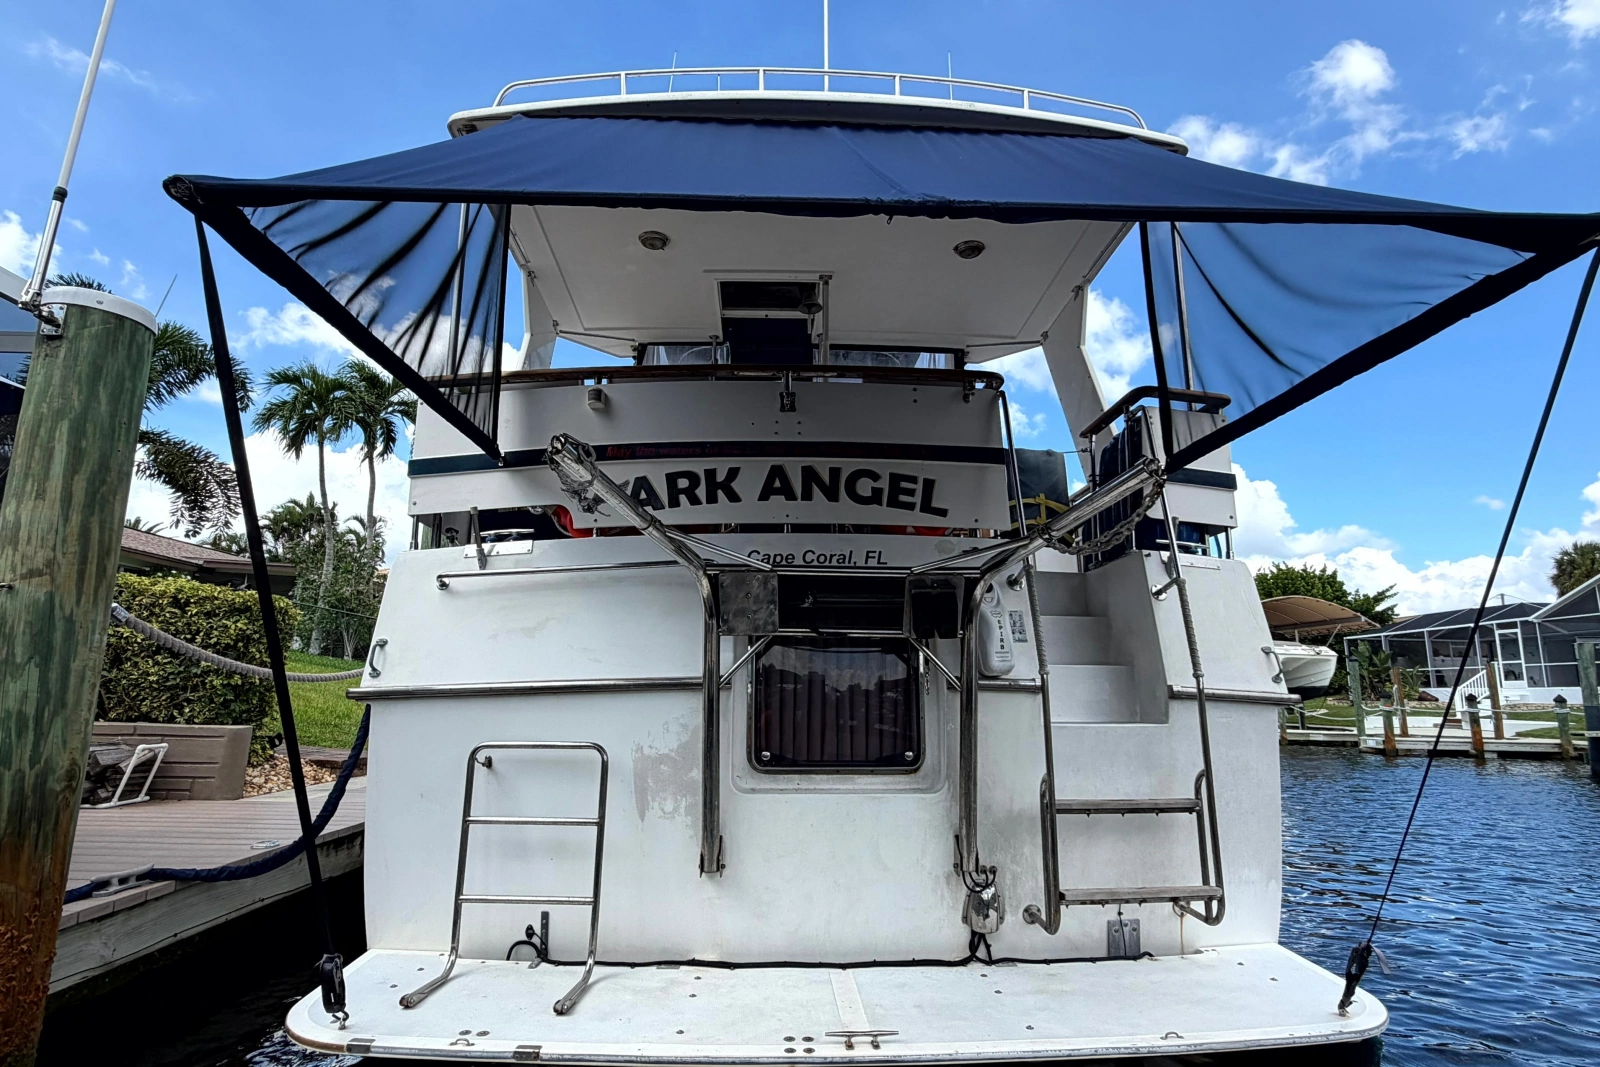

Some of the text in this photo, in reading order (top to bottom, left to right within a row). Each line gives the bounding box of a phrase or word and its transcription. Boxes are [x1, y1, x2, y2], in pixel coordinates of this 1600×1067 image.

[606, 446, 631, 459] May
[635, 446, 656, 457] the
[628, 464, 949, 518] ARK ANGEL
[747, 549, 888, 567] Cape Coral, FL
